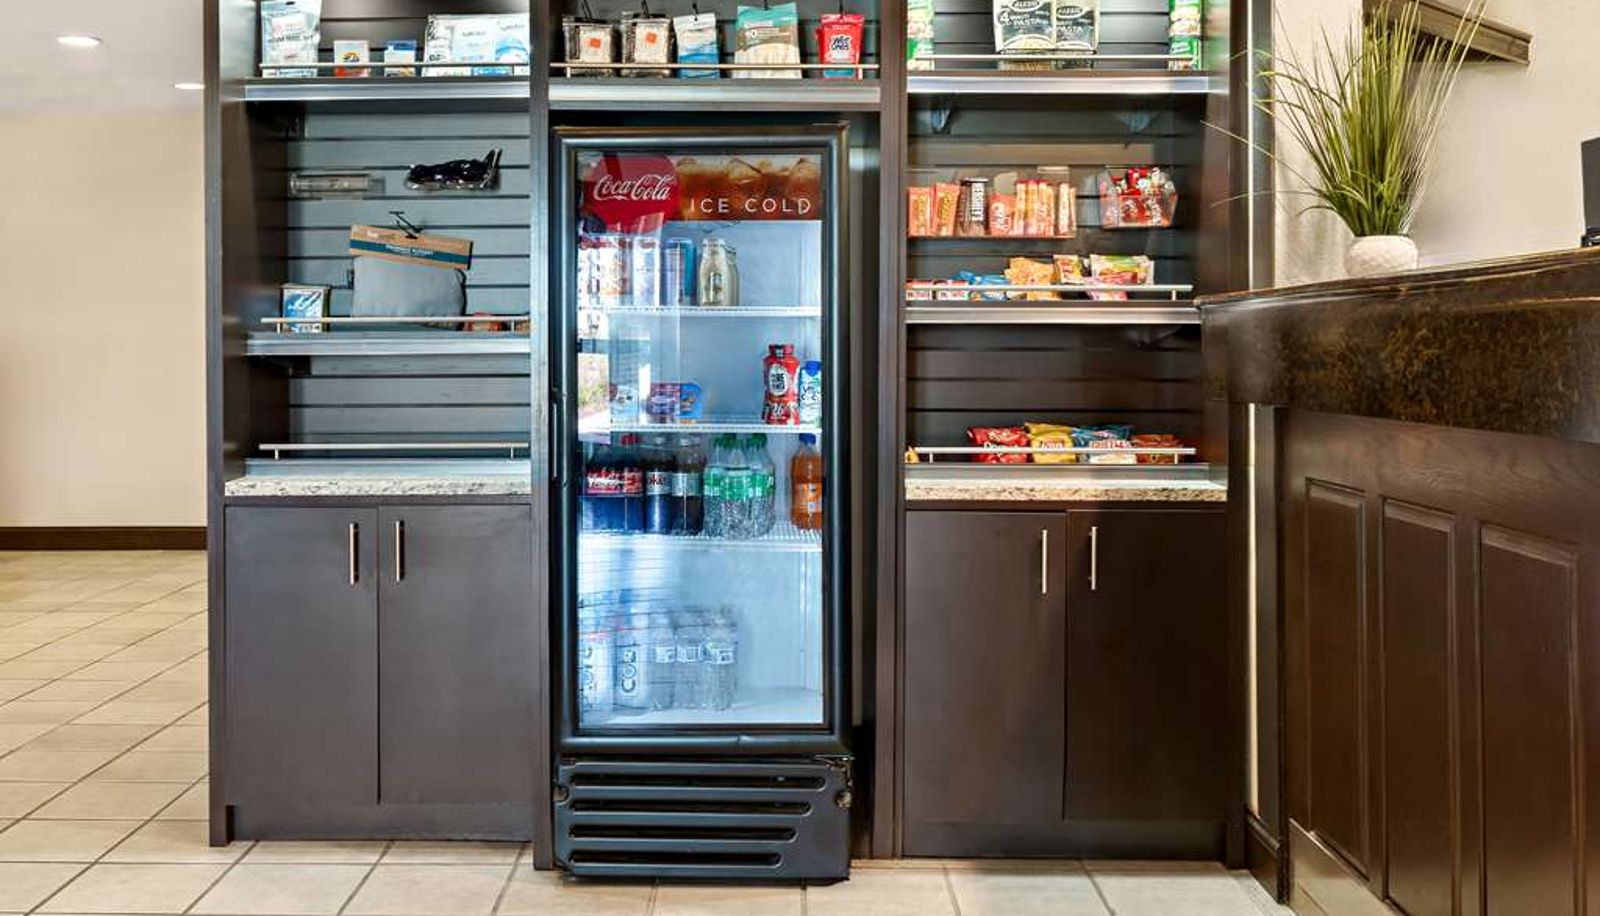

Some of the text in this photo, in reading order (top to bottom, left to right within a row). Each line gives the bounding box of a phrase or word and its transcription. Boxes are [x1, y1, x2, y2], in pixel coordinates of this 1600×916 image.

[593, 173, 675, 202] Coca-Cola
[690, 198, 812, 215] ICE COLD
